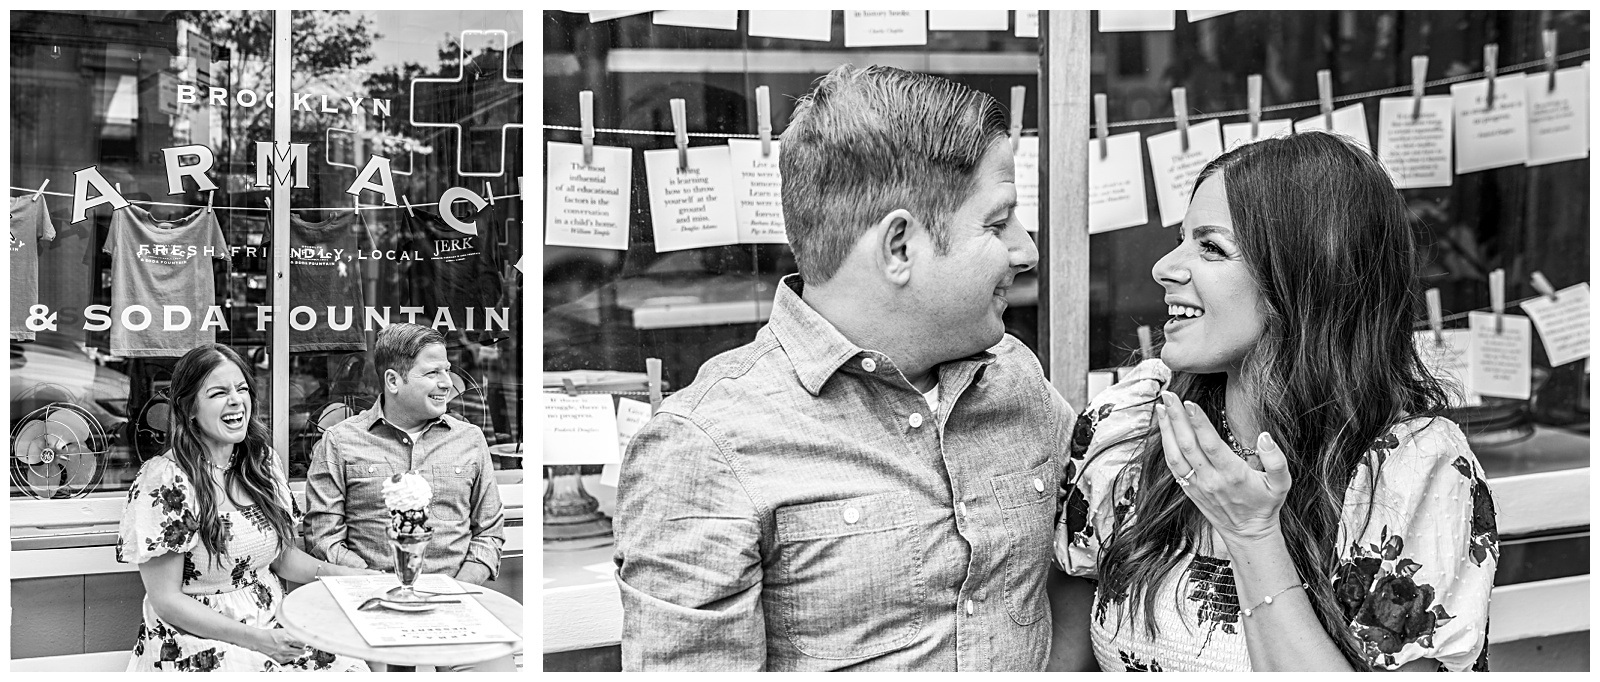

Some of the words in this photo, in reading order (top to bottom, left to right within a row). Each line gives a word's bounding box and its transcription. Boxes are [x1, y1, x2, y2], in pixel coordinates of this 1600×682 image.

[177, 84, 392, 117] BROOKLYN
[571, 162, 585, 170] The
[569, 175, 606, 183] influential
[742, 171, 755, 179] you
[677, 177, 709, 185] learning
[577, 186, 619, 195] educational
[665, 187, 680, 195] how
[749, 188, 771, 197] Learn
[564, 196, 589, 204] factors
[664, 196, 693, 207] yourself
[706, 194, 717, 202] the
[741, 200, 754, 208] you
[563, 208, 609, 216] conversation
[679, 205, 706, 215] ground
[570, 218, 593, 226] child's
[676, 216, 690, 224] and
[433, 237, 474, 257] JERK
[358, 250, 424, 261] LOCAL
[25, 304, 57, 331] &
[83, 304, 230, 332] SODA
[256, 305, 510, 331] FOUNTAIN
